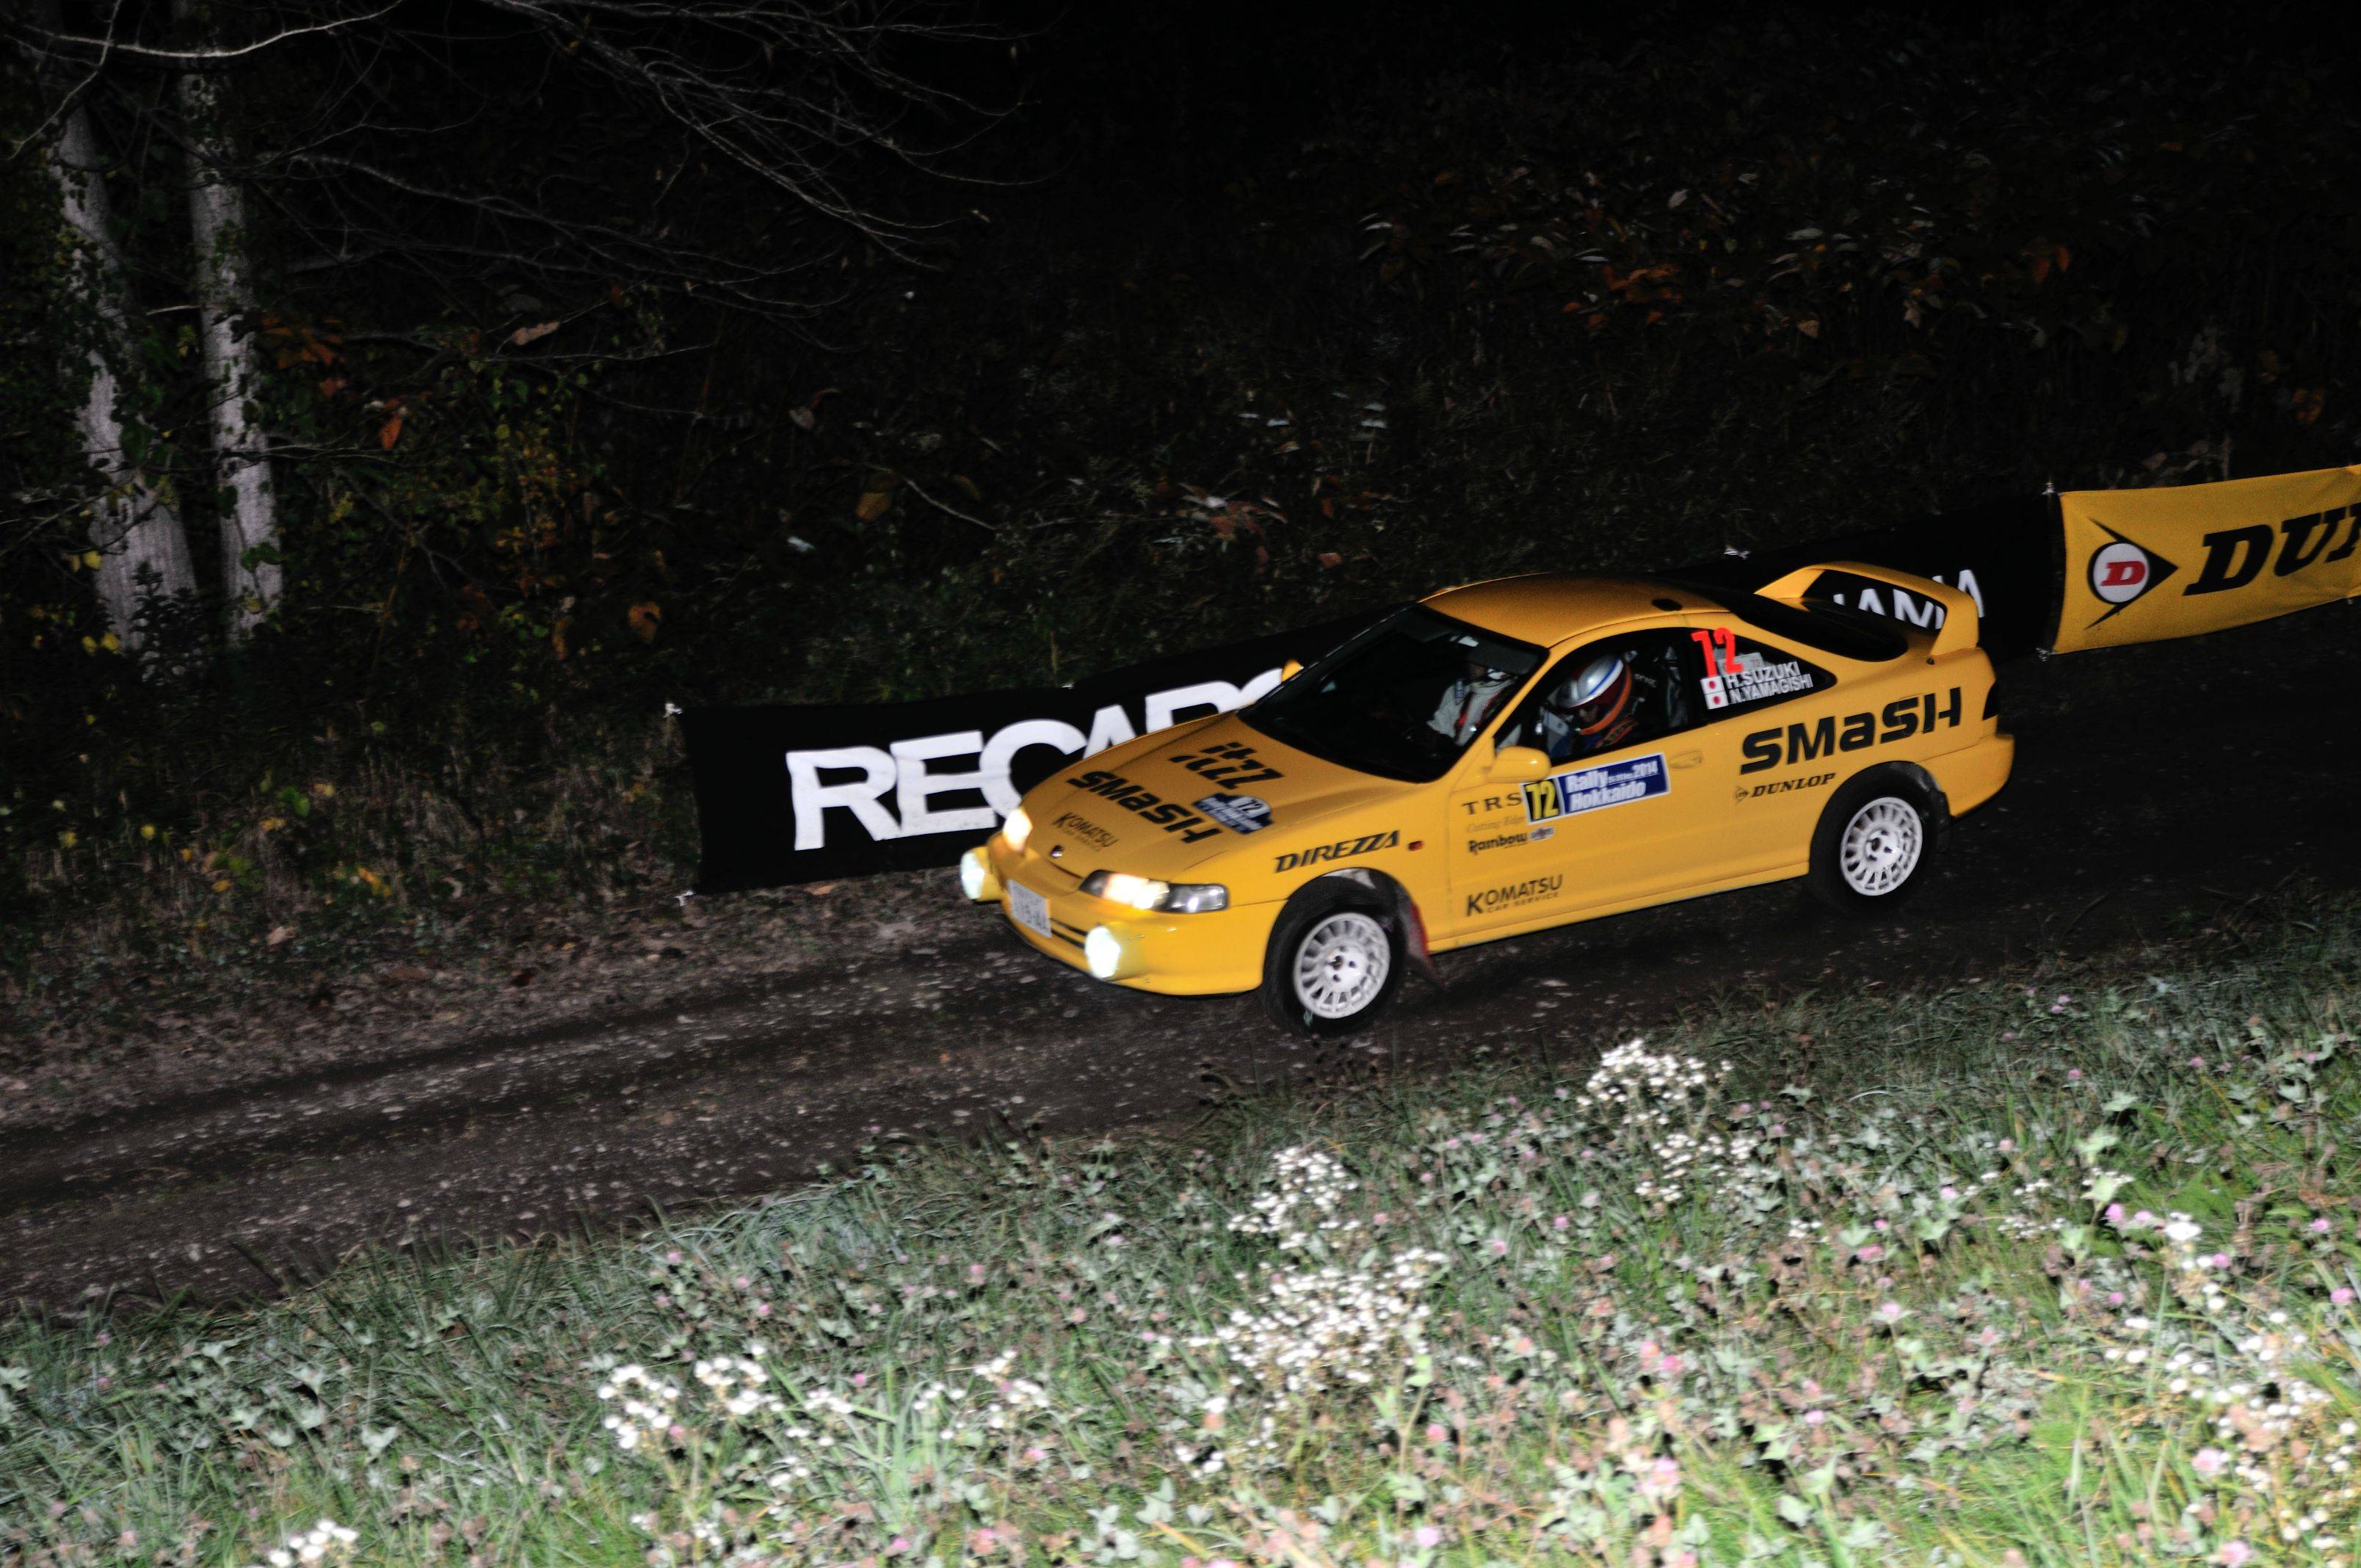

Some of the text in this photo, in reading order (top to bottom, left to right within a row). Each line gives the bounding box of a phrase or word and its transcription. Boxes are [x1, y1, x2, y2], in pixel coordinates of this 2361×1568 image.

[1691, 628, 1744, 678] 12
[1565, 769, 1609, 794] Rally
[1631, 761, 1658, 777] 2014
[1751, 772, 1836, 798] DUNLOP
[1462, 792, 1523, 815] TRS
[1525, 780, 1559, 821] 12
[1570, 780, 1647, 812] Hokkaido
[1052, 812, 1120, 847] KOMATSU
[1274, 830, 1400, 874] DIREZZA
[1466, 874, 1563, 917] KOMATSU
